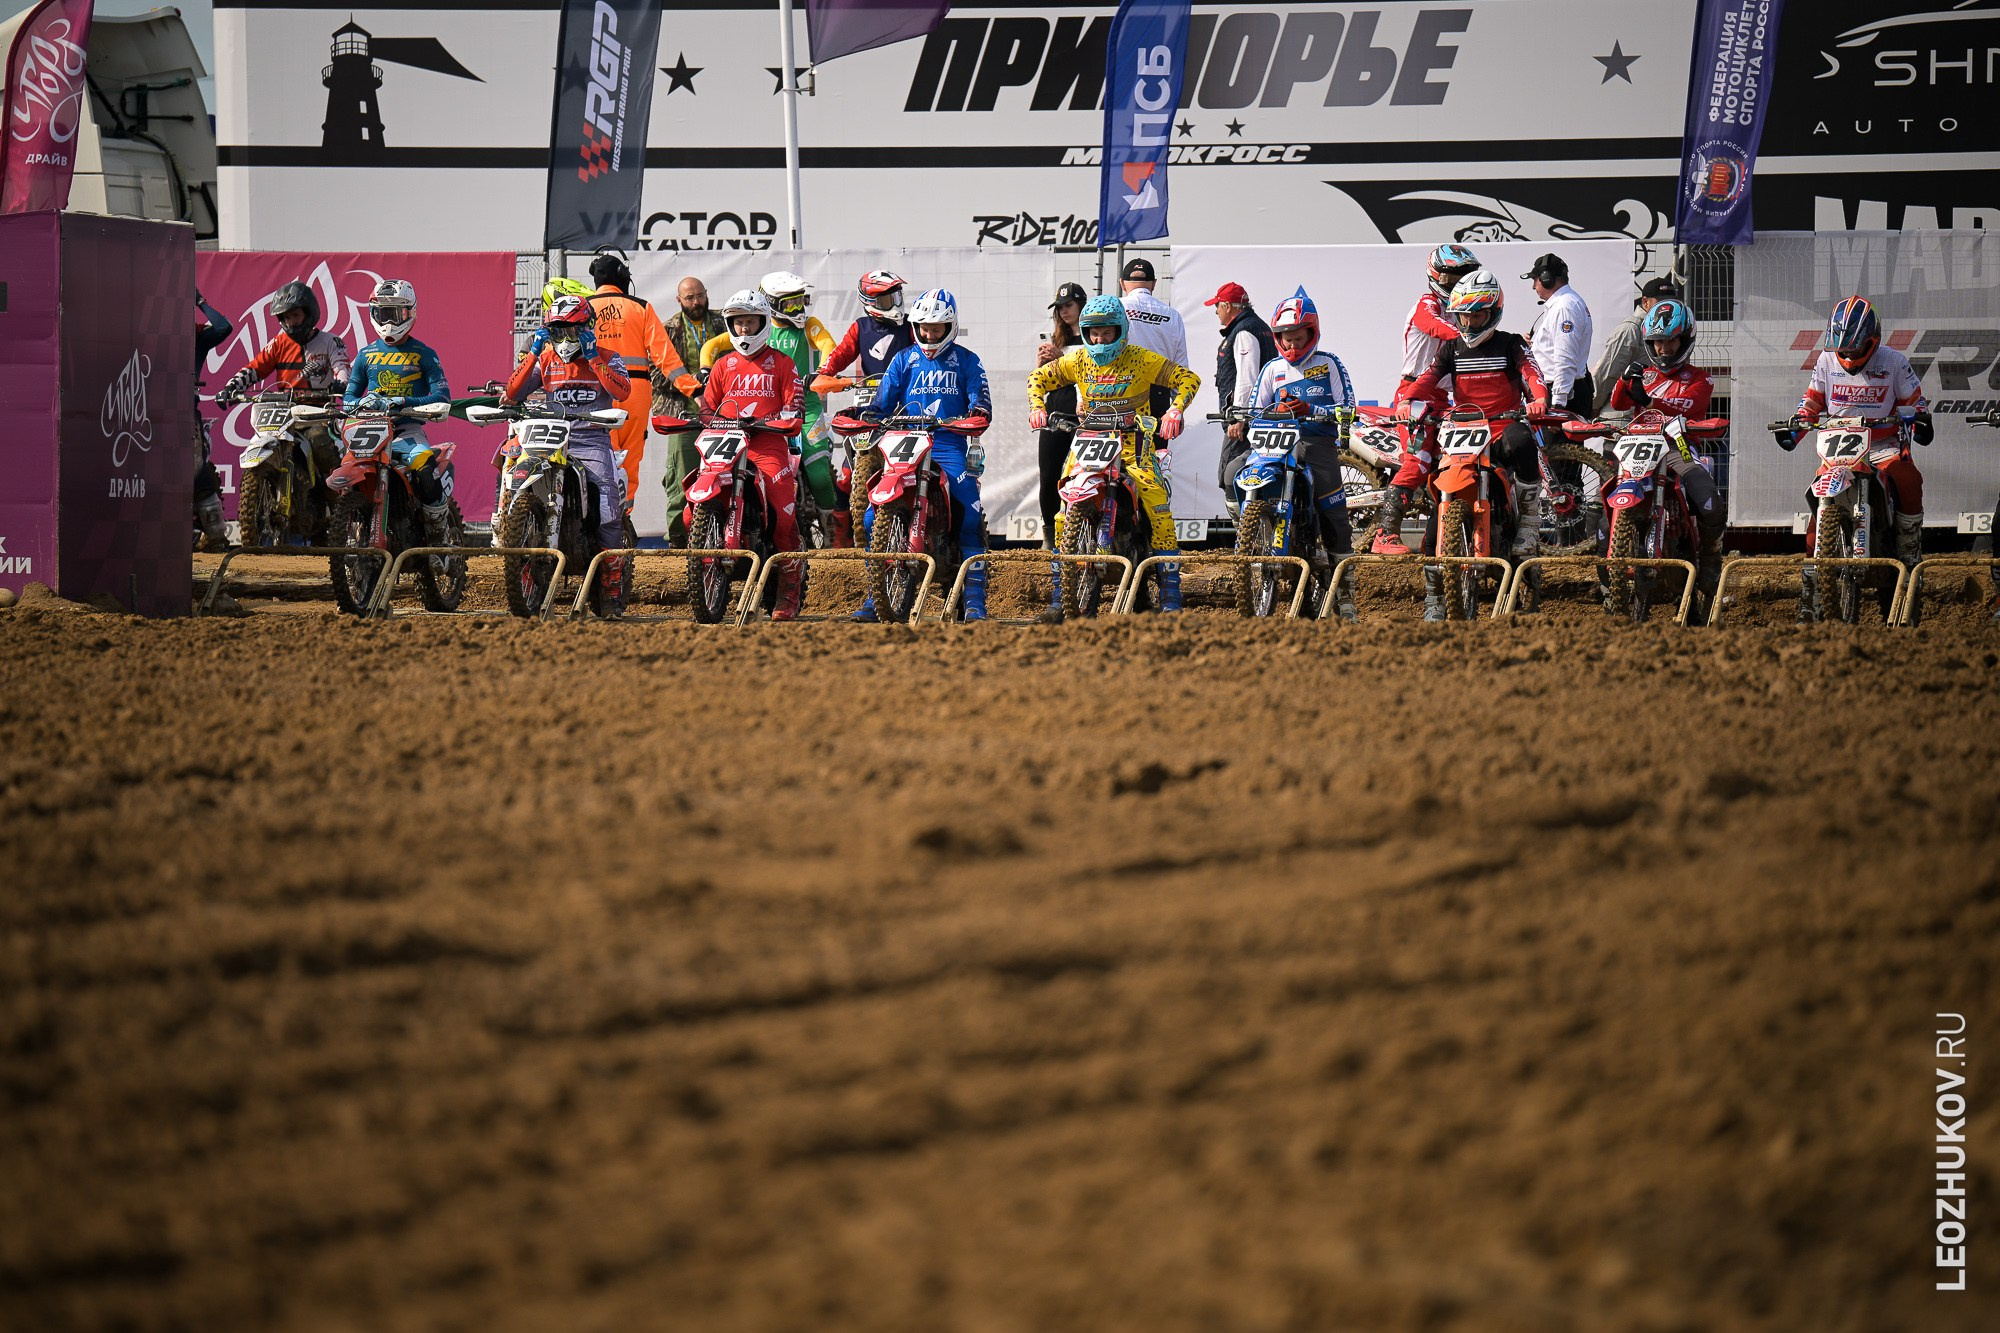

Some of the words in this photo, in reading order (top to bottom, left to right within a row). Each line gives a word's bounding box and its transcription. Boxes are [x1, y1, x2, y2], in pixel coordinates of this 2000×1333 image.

[584, 0, 621, 137] RGP
[623, 46, 632, 76] PRIX
[1708, 11, 1738, 122] ФЕДЕРАЦИЯ
[1722, 0, 1757, 124] МОТОЦИКЛЕТ
[1739, 56, 1763, 125] СПОРТА
[1752, 0, 1770, 50] РОСС
[618, 76, 629, 119] GRAND
[1132, 45, 1171, 146] ПСБ
[1812, 117, 1958, 135] AUTO
[612, 119, 624, 172] RUSSIAN
[25, 153, 67, 166] ДРАЙВ
[769, 339, 797, 349] EVEN
[365, 352, 422, 366] THOR
[726, 390, 776, 398] MOTORSPORTS
[909, 387, 959, 396] MOTORSPORTS
[1833, 385, 1886, 397] MILYAEV
[256, 409, 291, 426] 86
[349, 427, 387, 450] 5
[521, 424, 568, 445] 123
[1251, 430, 1297, 450] 500
[1443, 429, 1489, 449] 170
[702, 436, 742, 460] 74
[889, 436, 920, 462] 4
[1074, 439, 1120, 462] 730
[1619, 442, 1663, 462] 761
[1825, 433, 1863, 458] 12
[109, 474, 146, 498] ДРАЙВ
[1013, 518, 1038, 538] 19
[1175, 521, 1201, 540] 18
[1965, 514, 1992, 532] 13
